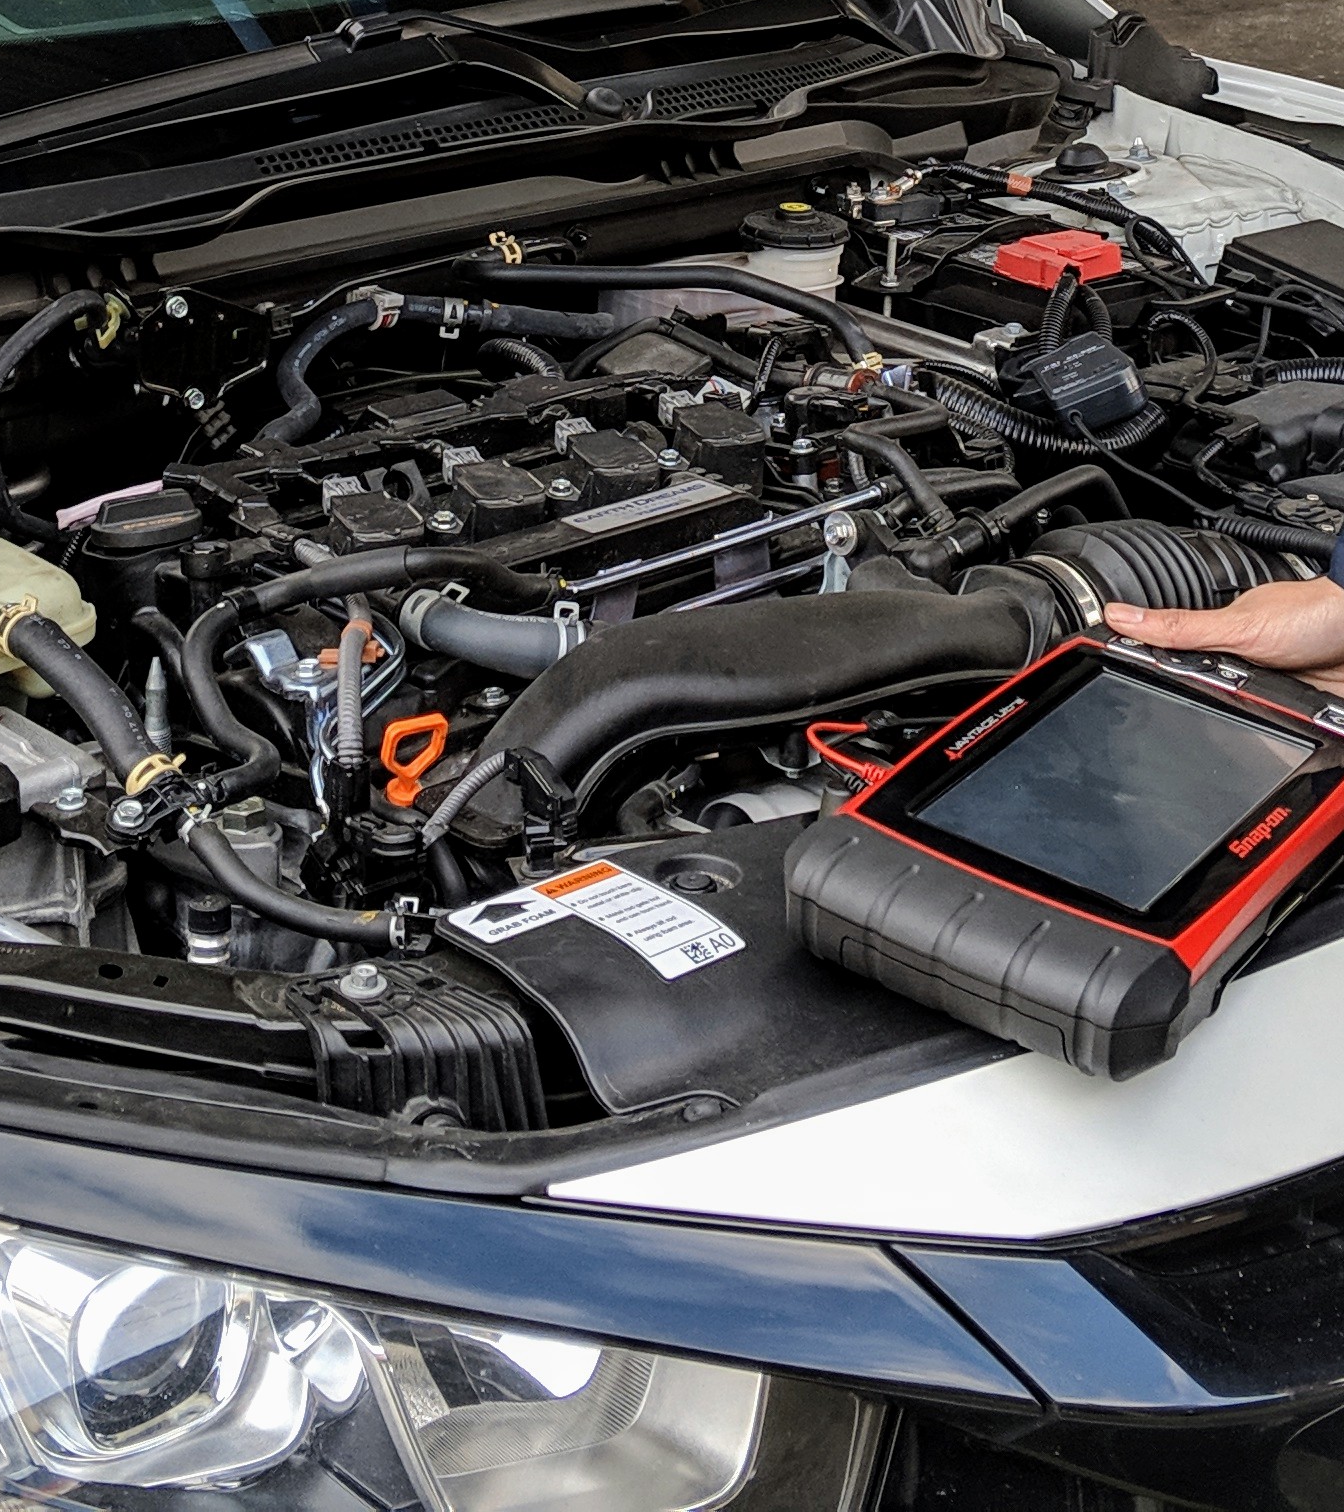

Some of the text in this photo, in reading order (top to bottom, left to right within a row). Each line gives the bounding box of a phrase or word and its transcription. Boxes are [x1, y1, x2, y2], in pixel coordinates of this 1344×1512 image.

[1228, 807, 1290, 859] Snap-on
[555, 866, 613, 890] WARNING
[488, 908, 557, 936] GRAB FOAM
